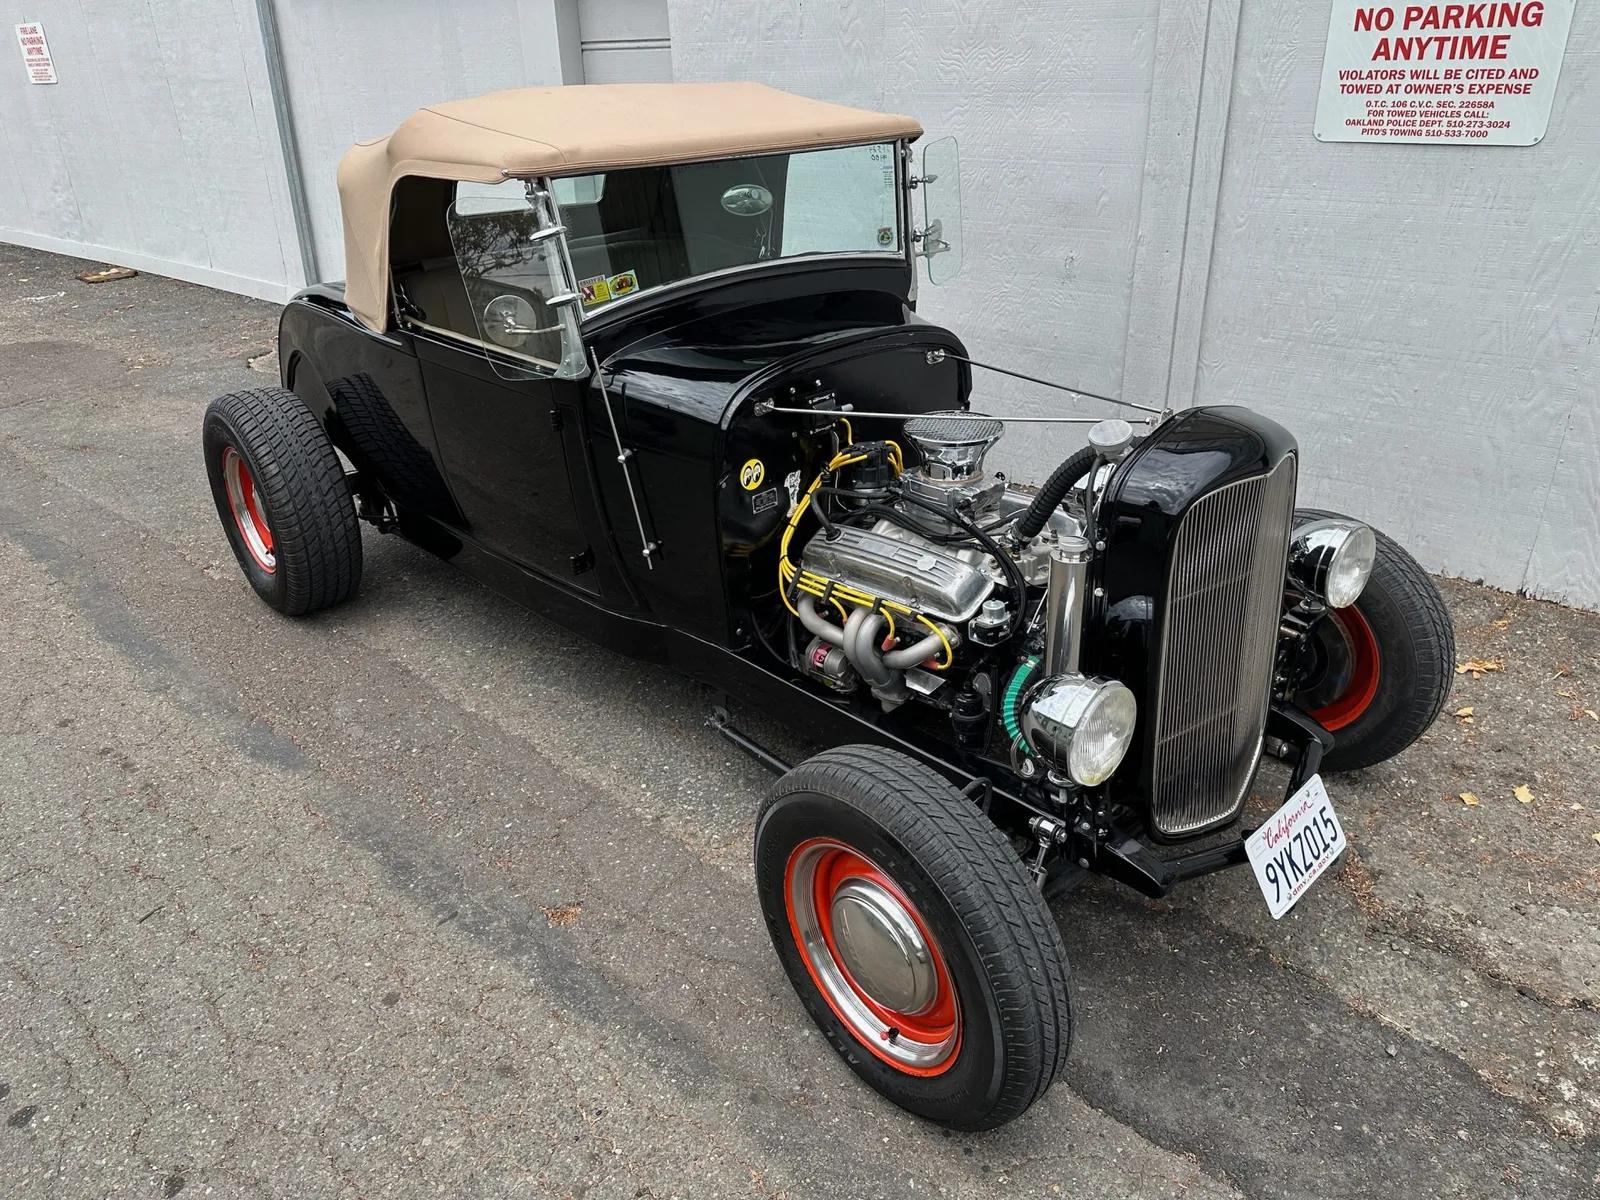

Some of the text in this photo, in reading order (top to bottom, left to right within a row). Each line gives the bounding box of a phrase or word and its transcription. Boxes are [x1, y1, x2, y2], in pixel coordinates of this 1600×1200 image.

[1353, 1, 1545, 32] NO PARKING
[1371, 34, 1511, 62] ANYTIME
[1338, 68, 1540, 81] VIOLATORS WILL BE CITED AND
[1339, 83, 1532, 95] TOWED AT OWNER'S EXPENSE
[1365, 100, 1495, 109] O.T.C. 106 C.V.C. SEC. 22658A
[1367, 110, 1489, 119] FOR TOWED VEHICLES CALL:
[1345, 119, 1510, 129] OAKLAND POLICE DEPT. 510-273-3024
[1361, 128, 1488, 138] PITO'S TOWING 510-533-7000
[1264, 798, 1316, 848] California
[1265, 806, 1337, 903] 9YKZ015
